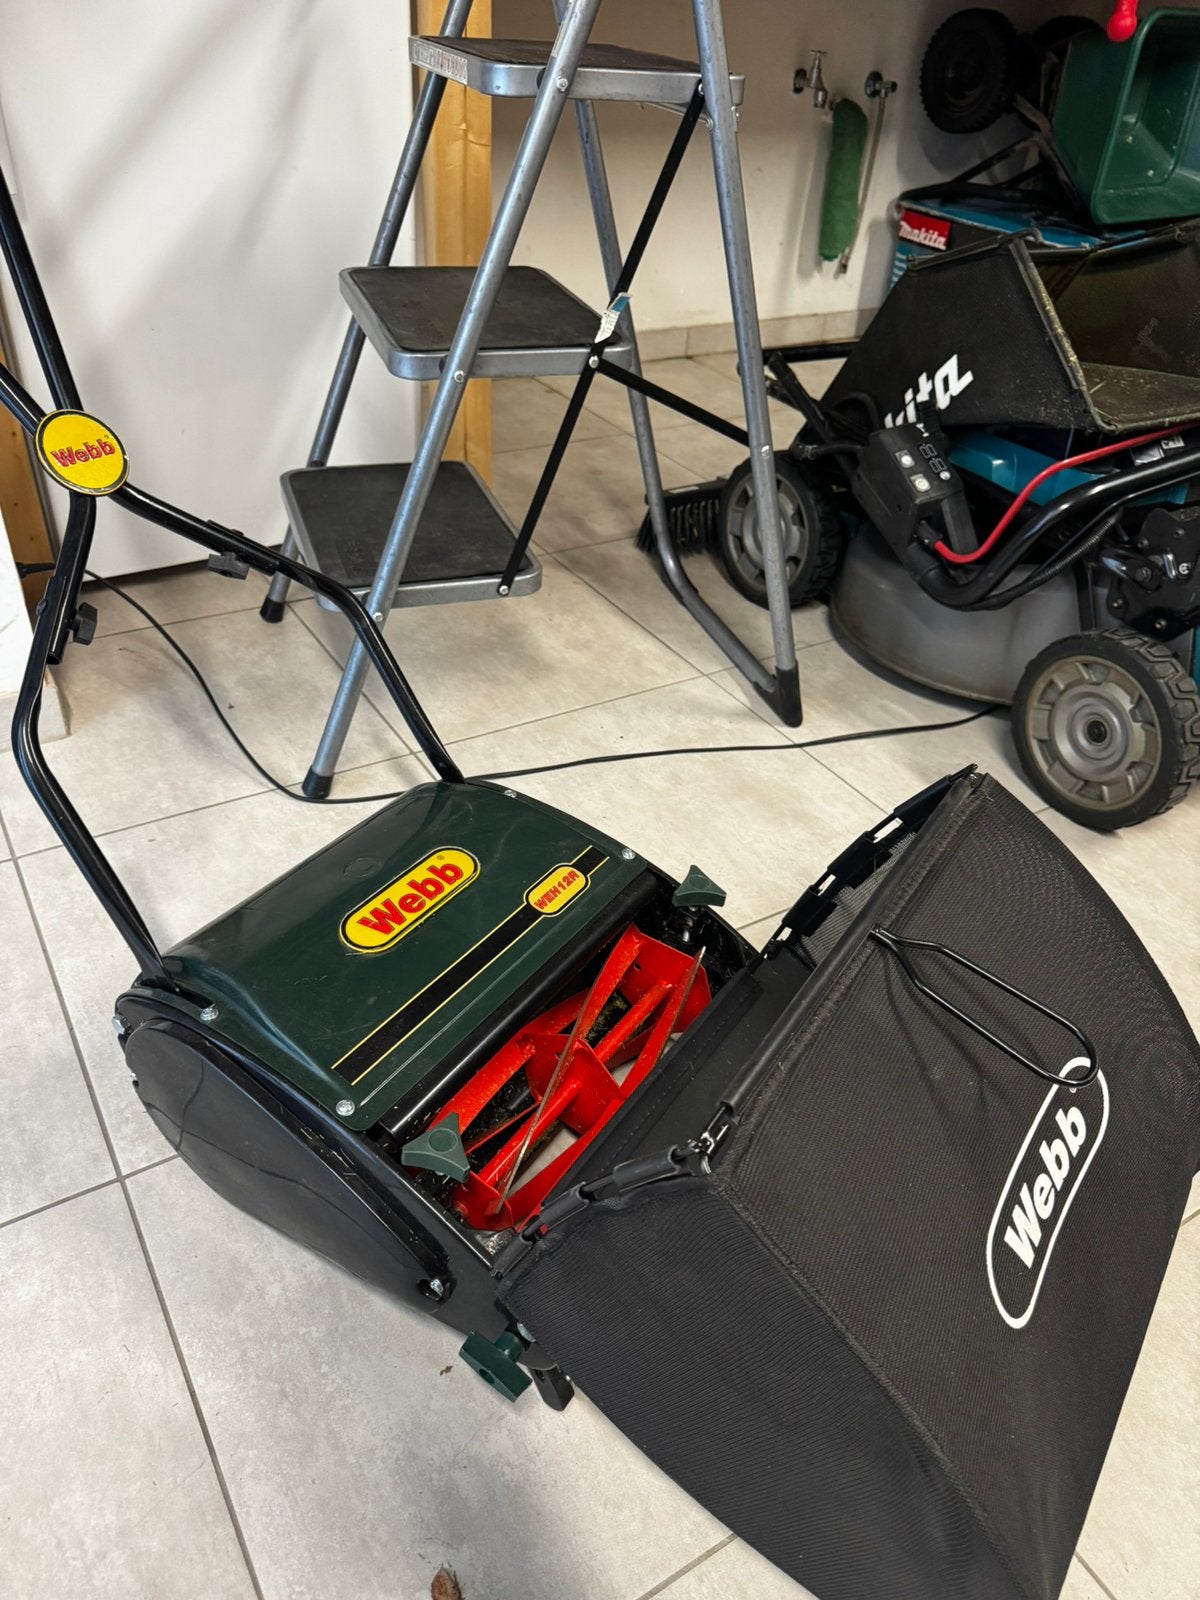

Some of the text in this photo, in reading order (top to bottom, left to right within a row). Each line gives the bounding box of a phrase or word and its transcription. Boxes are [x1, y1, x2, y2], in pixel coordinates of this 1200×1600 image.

[50, 439, 115, 467] Webb
[357, 863, 464, 935] Webb
[1004, 1106, 1087, 1269] Webb
